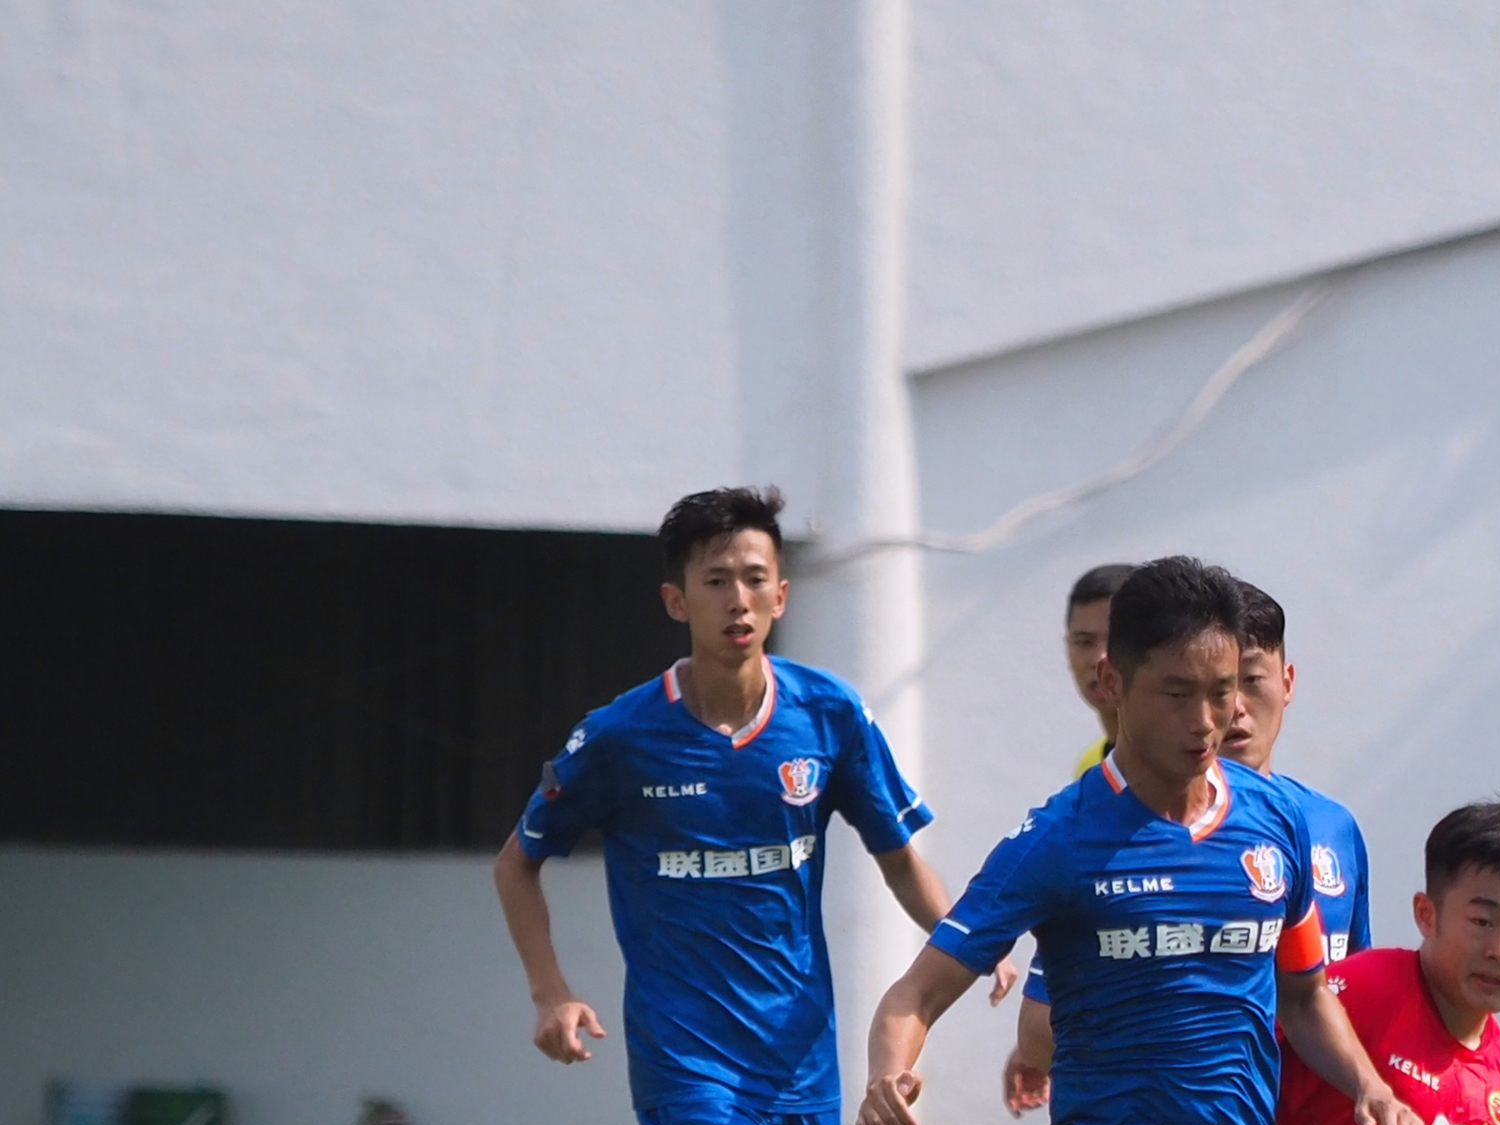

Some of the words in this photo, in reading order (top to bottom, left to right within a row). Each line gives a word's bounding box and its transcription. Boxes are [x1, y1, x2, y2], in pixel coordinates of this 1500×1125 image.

[642, 782, 708, 798] KELME
[1095, 877, 1174, 896] KELME
[1388, 1053, 1441, 1091] KELME
